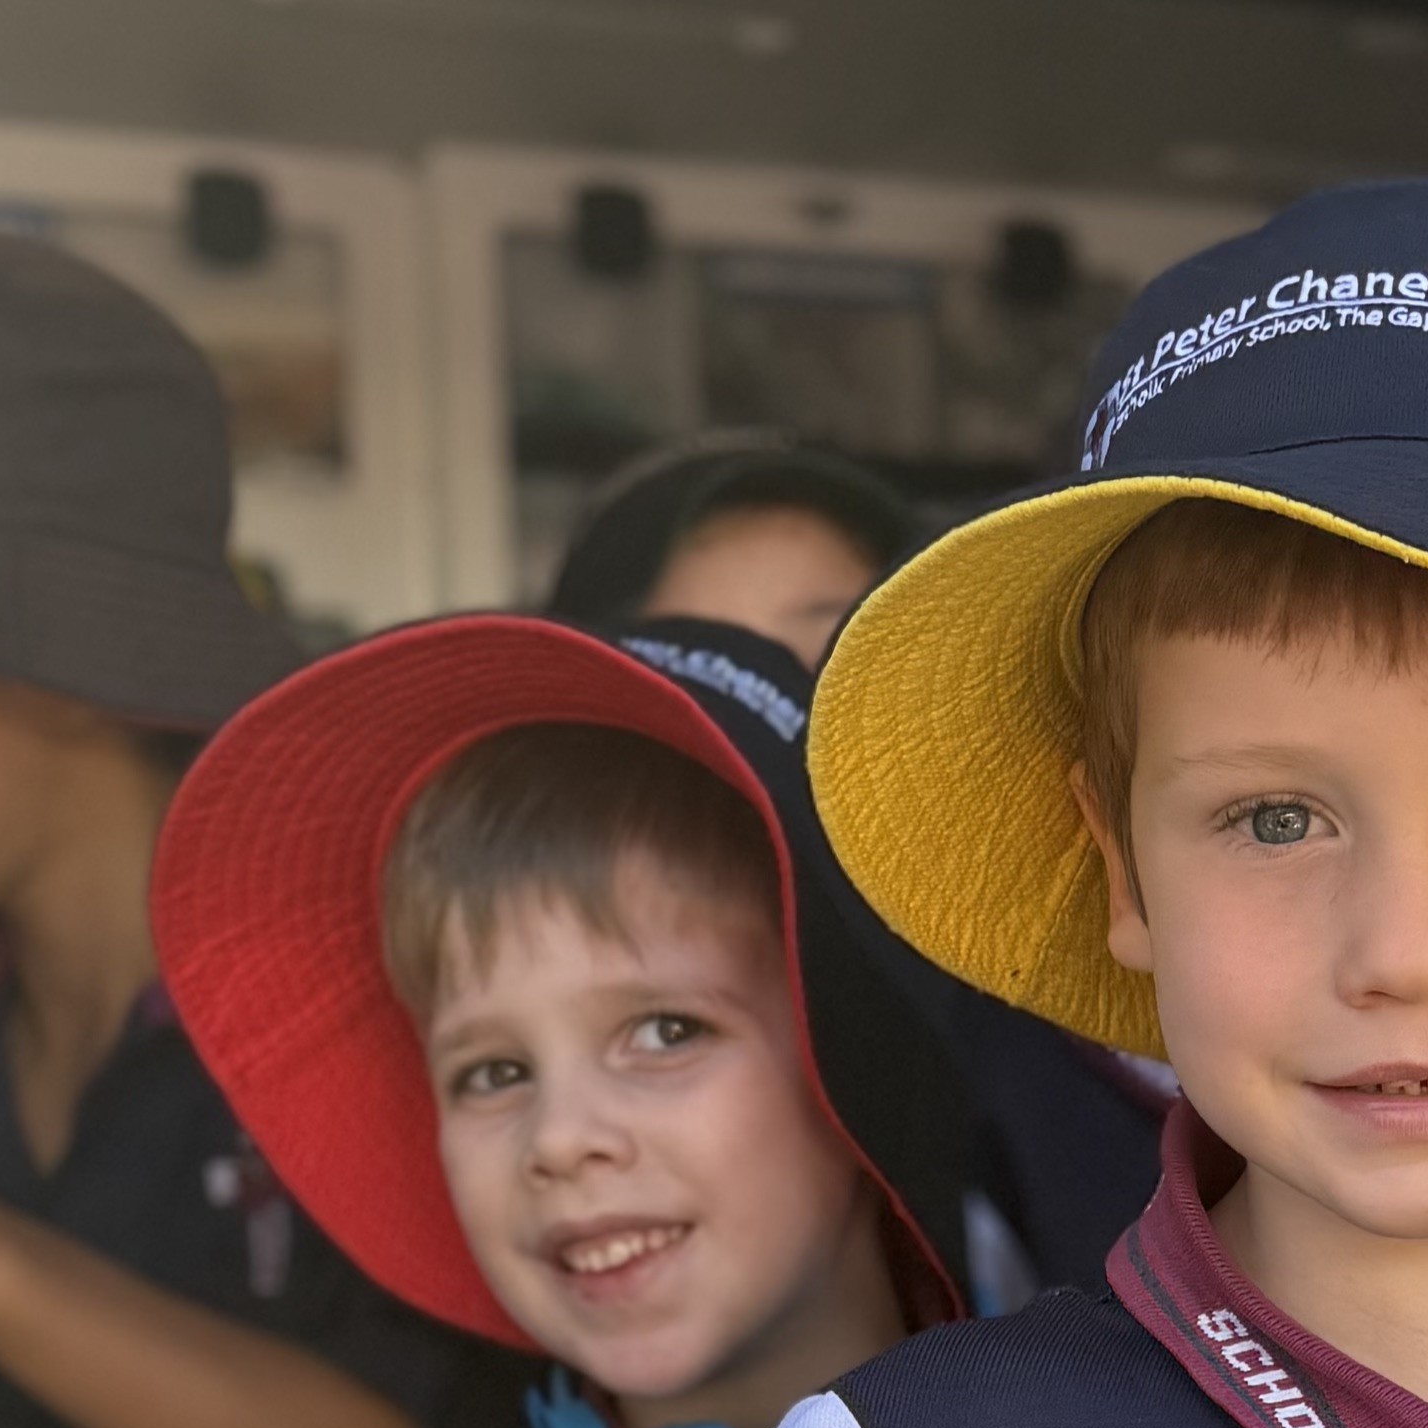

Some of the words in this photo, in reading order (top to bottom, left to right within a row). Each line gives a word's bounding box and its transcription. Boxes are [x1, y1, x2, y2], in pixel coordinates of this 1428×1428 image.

[1150, 295, 1257, 371] Peter
[1170, 334, 1245, 386] Primary
[1246, 309, 1332, 347] School,
[1335, 306, 1384, 328] The
